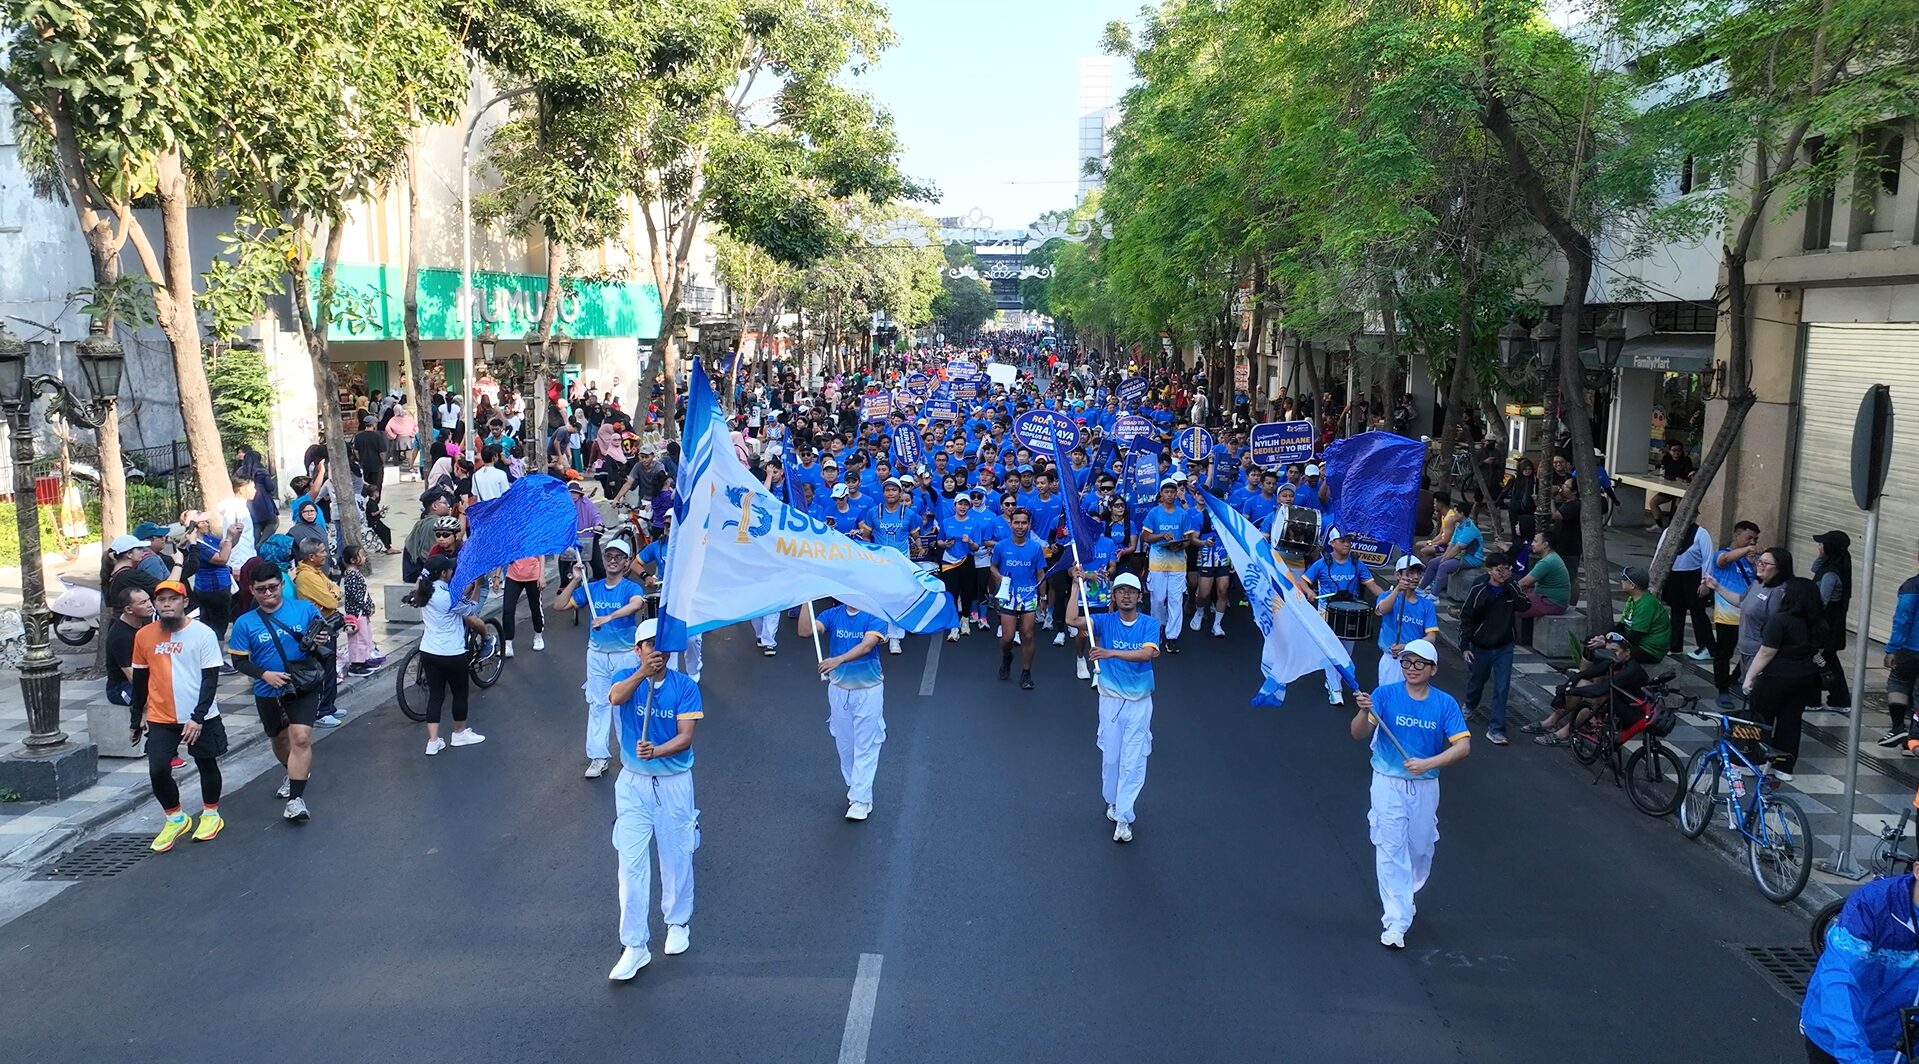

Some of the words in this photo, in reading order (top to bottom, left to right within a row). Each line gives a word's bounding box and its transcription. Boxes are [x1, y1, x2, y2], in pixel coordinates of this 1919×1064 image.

[456, 287, 579, 323] MUMUO
[1633, 356, 1670, 369] FamilyMart
[948, 390, 956, 400] 3
[861, 408, 869, 421] 3
[1032, 415, 1056, 425] ROA
[1056, 420, 1068, 429] TO
[1020, 430, 1043, 440] ISOPLUS
[1021, 422, 1075, 441] SURAAYA
[901, 427, 914, 462] SURABAYA
[1254, 439, 1280, 448] NYILIH
[1280, 436, 1311, 445] DALANE
[1253, 447, 1285, 455] SEDILUT
[1285, 444, 1297, 452] YO
[1297, 443, 1312, 451] REK
[1358, 543, 1378, 552] YOUR
[594, 601, 621, 609] ISOPLUS
[1397, 613, 1424, 625] ISOPLUS
[836, 629, 864, 639] ISOPLUS
[154, 646, 183, 655] RUN
[1395, 715, 1437, 730] ISOPLUS
